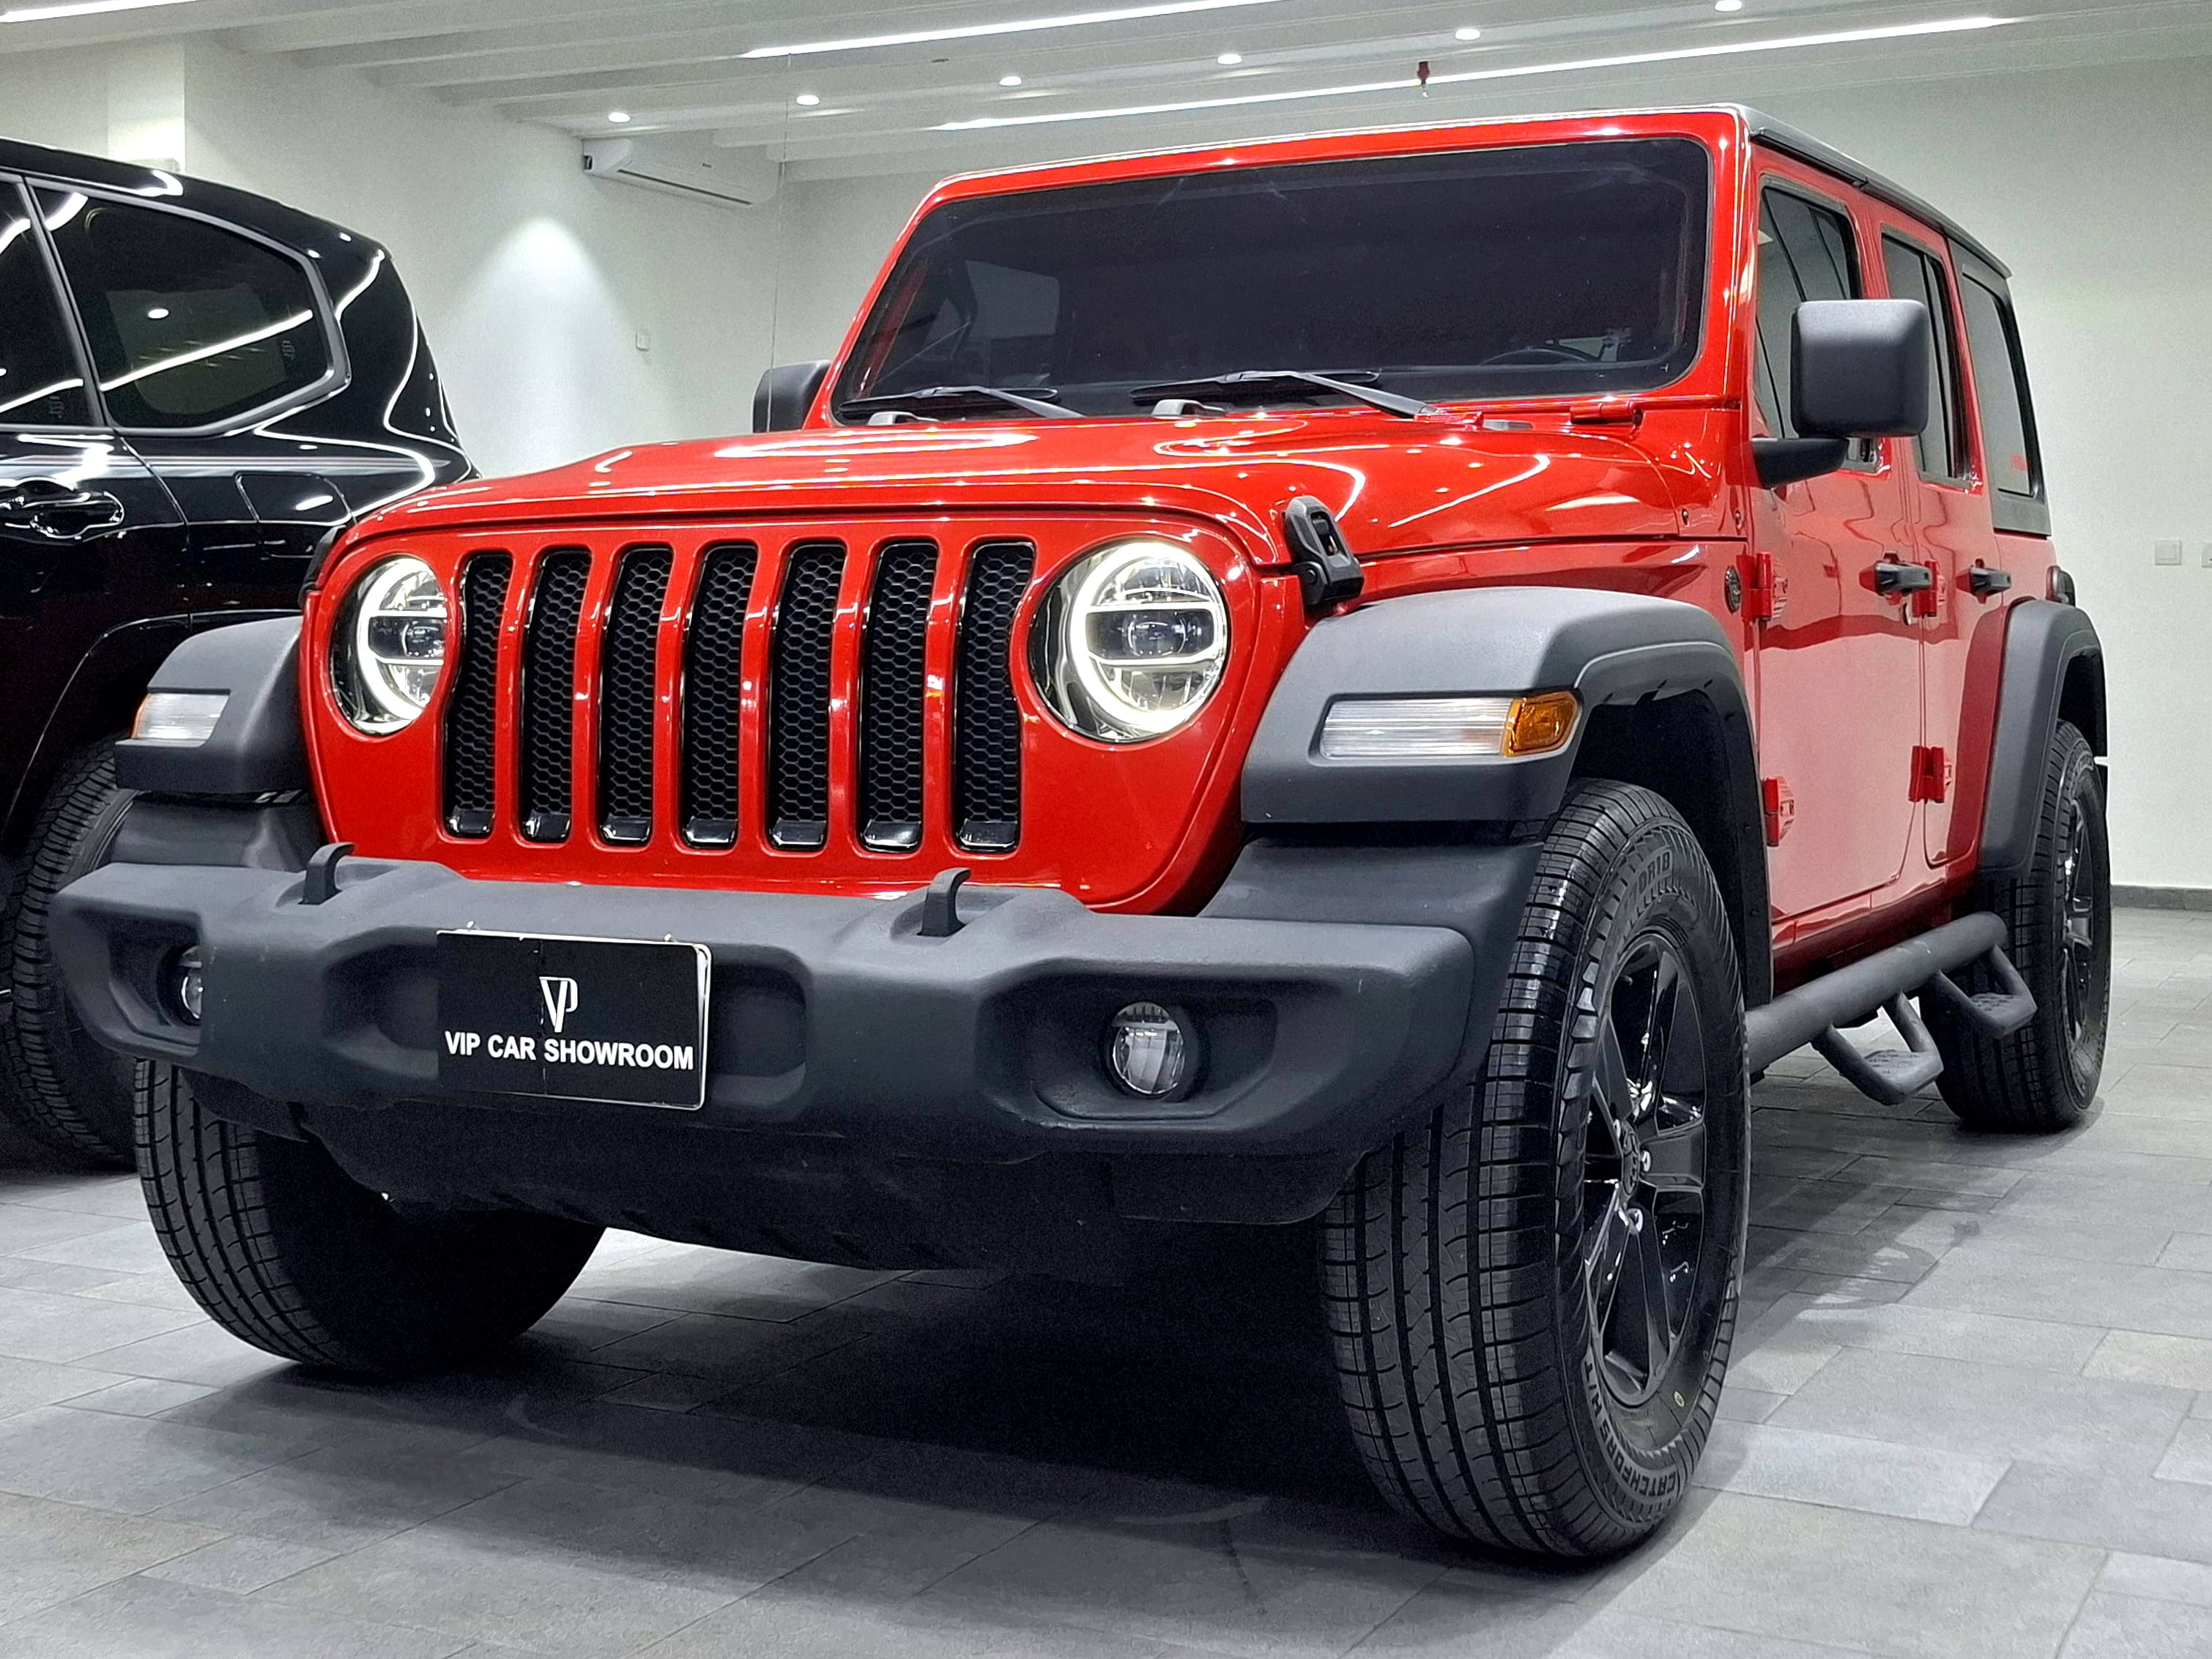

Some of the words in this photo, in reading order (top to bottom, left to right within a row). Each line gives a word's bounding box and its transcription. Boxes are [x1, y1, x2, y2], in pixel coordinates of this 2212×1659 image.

[445, 1031, 480, 1056] VIP
[488, 1033, 537, 1061] CAR
[544, 1038, 694, 1070] SHOWROOM
